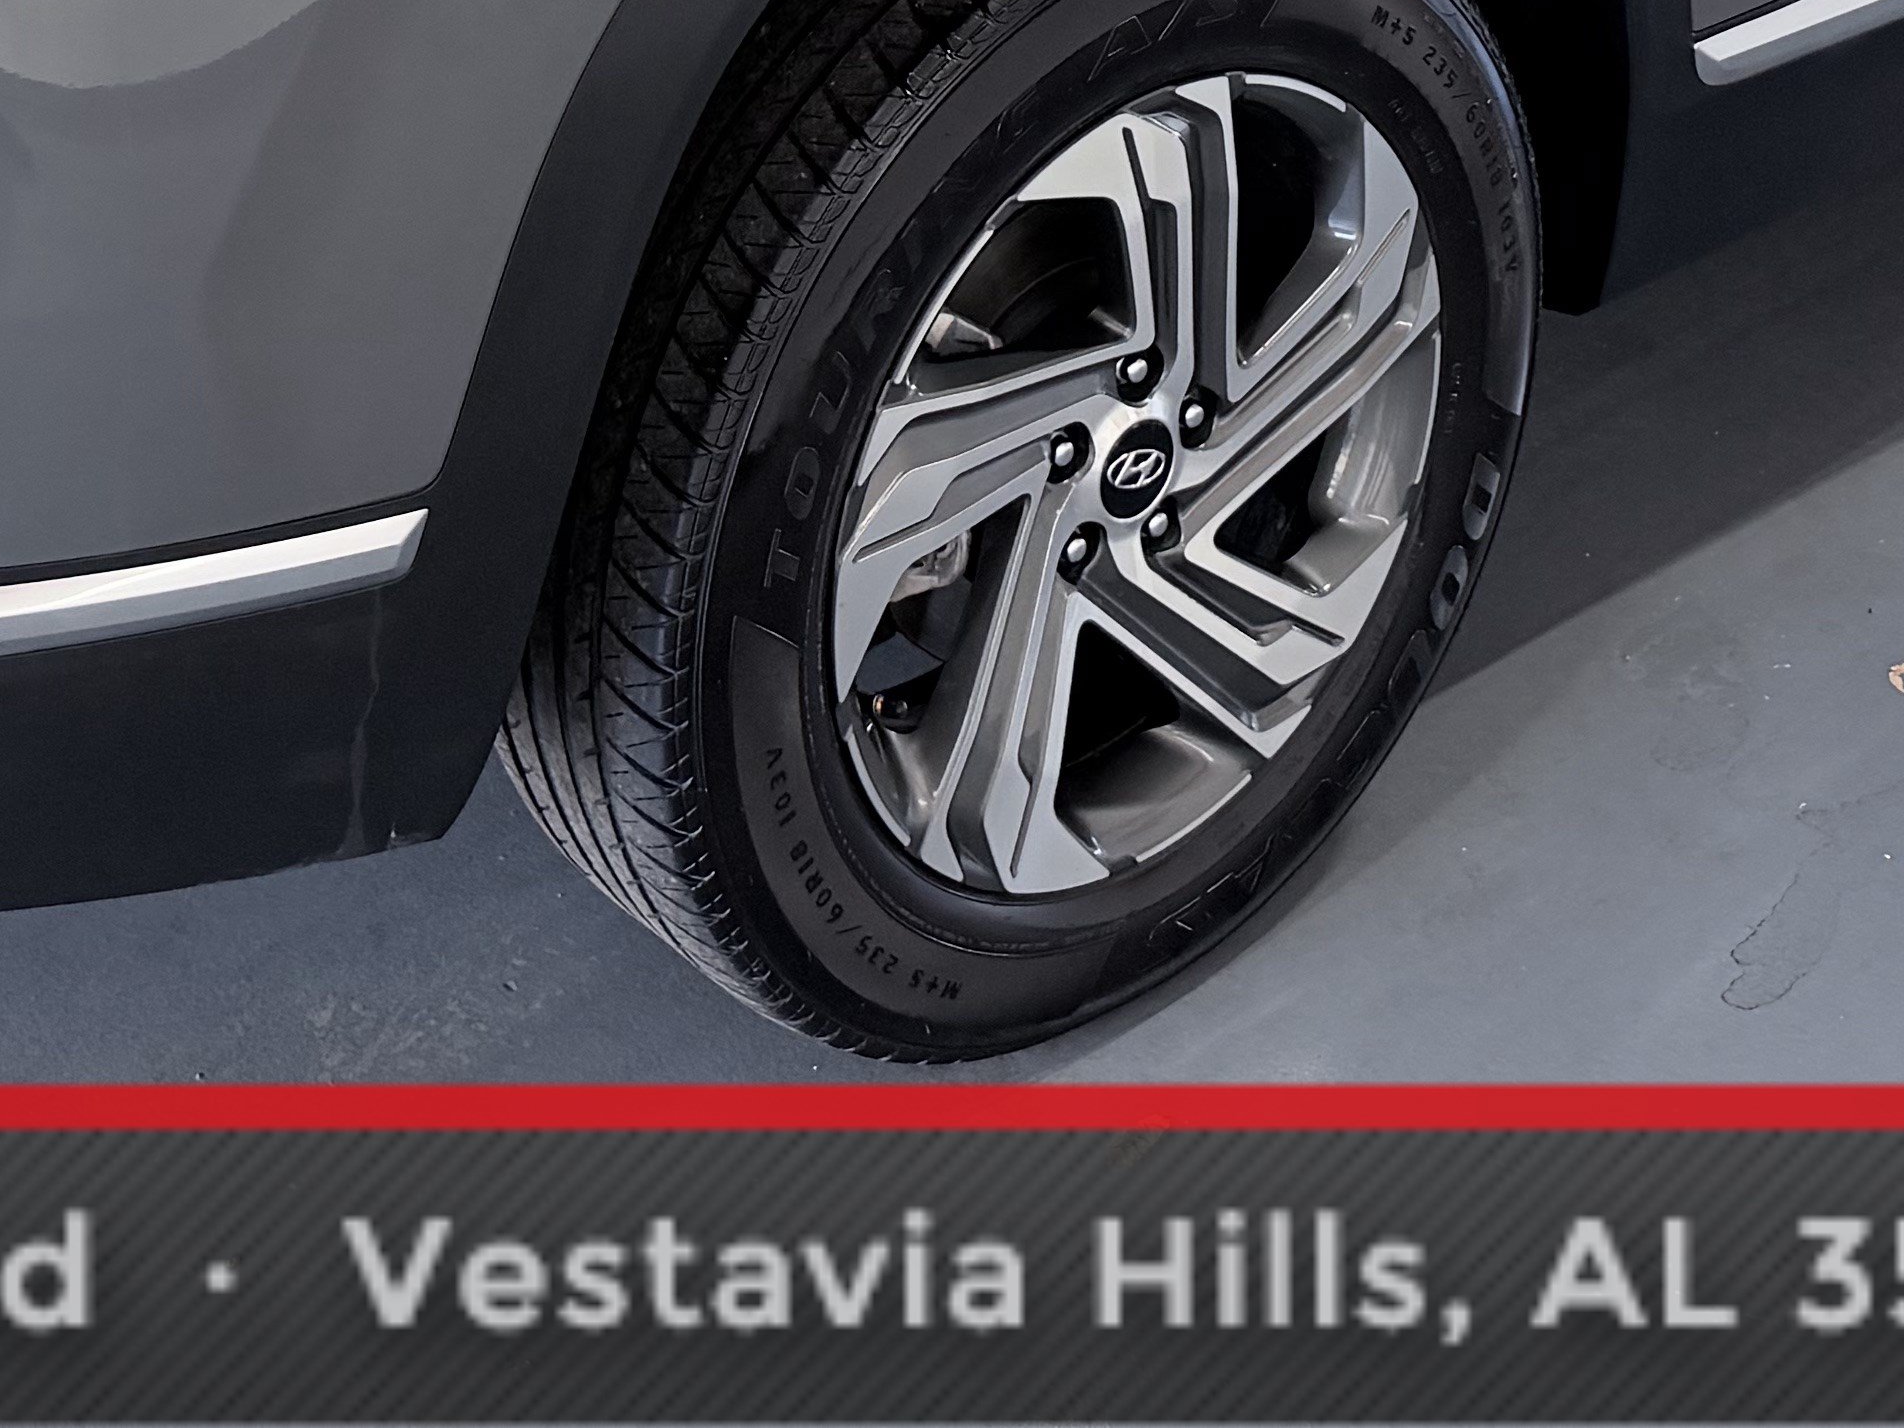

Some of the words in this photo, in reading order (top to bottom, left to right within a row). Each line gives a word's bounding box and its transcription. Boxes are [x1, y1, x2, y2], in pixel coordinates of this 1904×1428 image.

[1369, 4, 1417, 46] M+S
[766, 746, 798, 828] 103V
[788, 838, 900, 976] 235/60R18
[908, 967, 961, 1000] M+S
